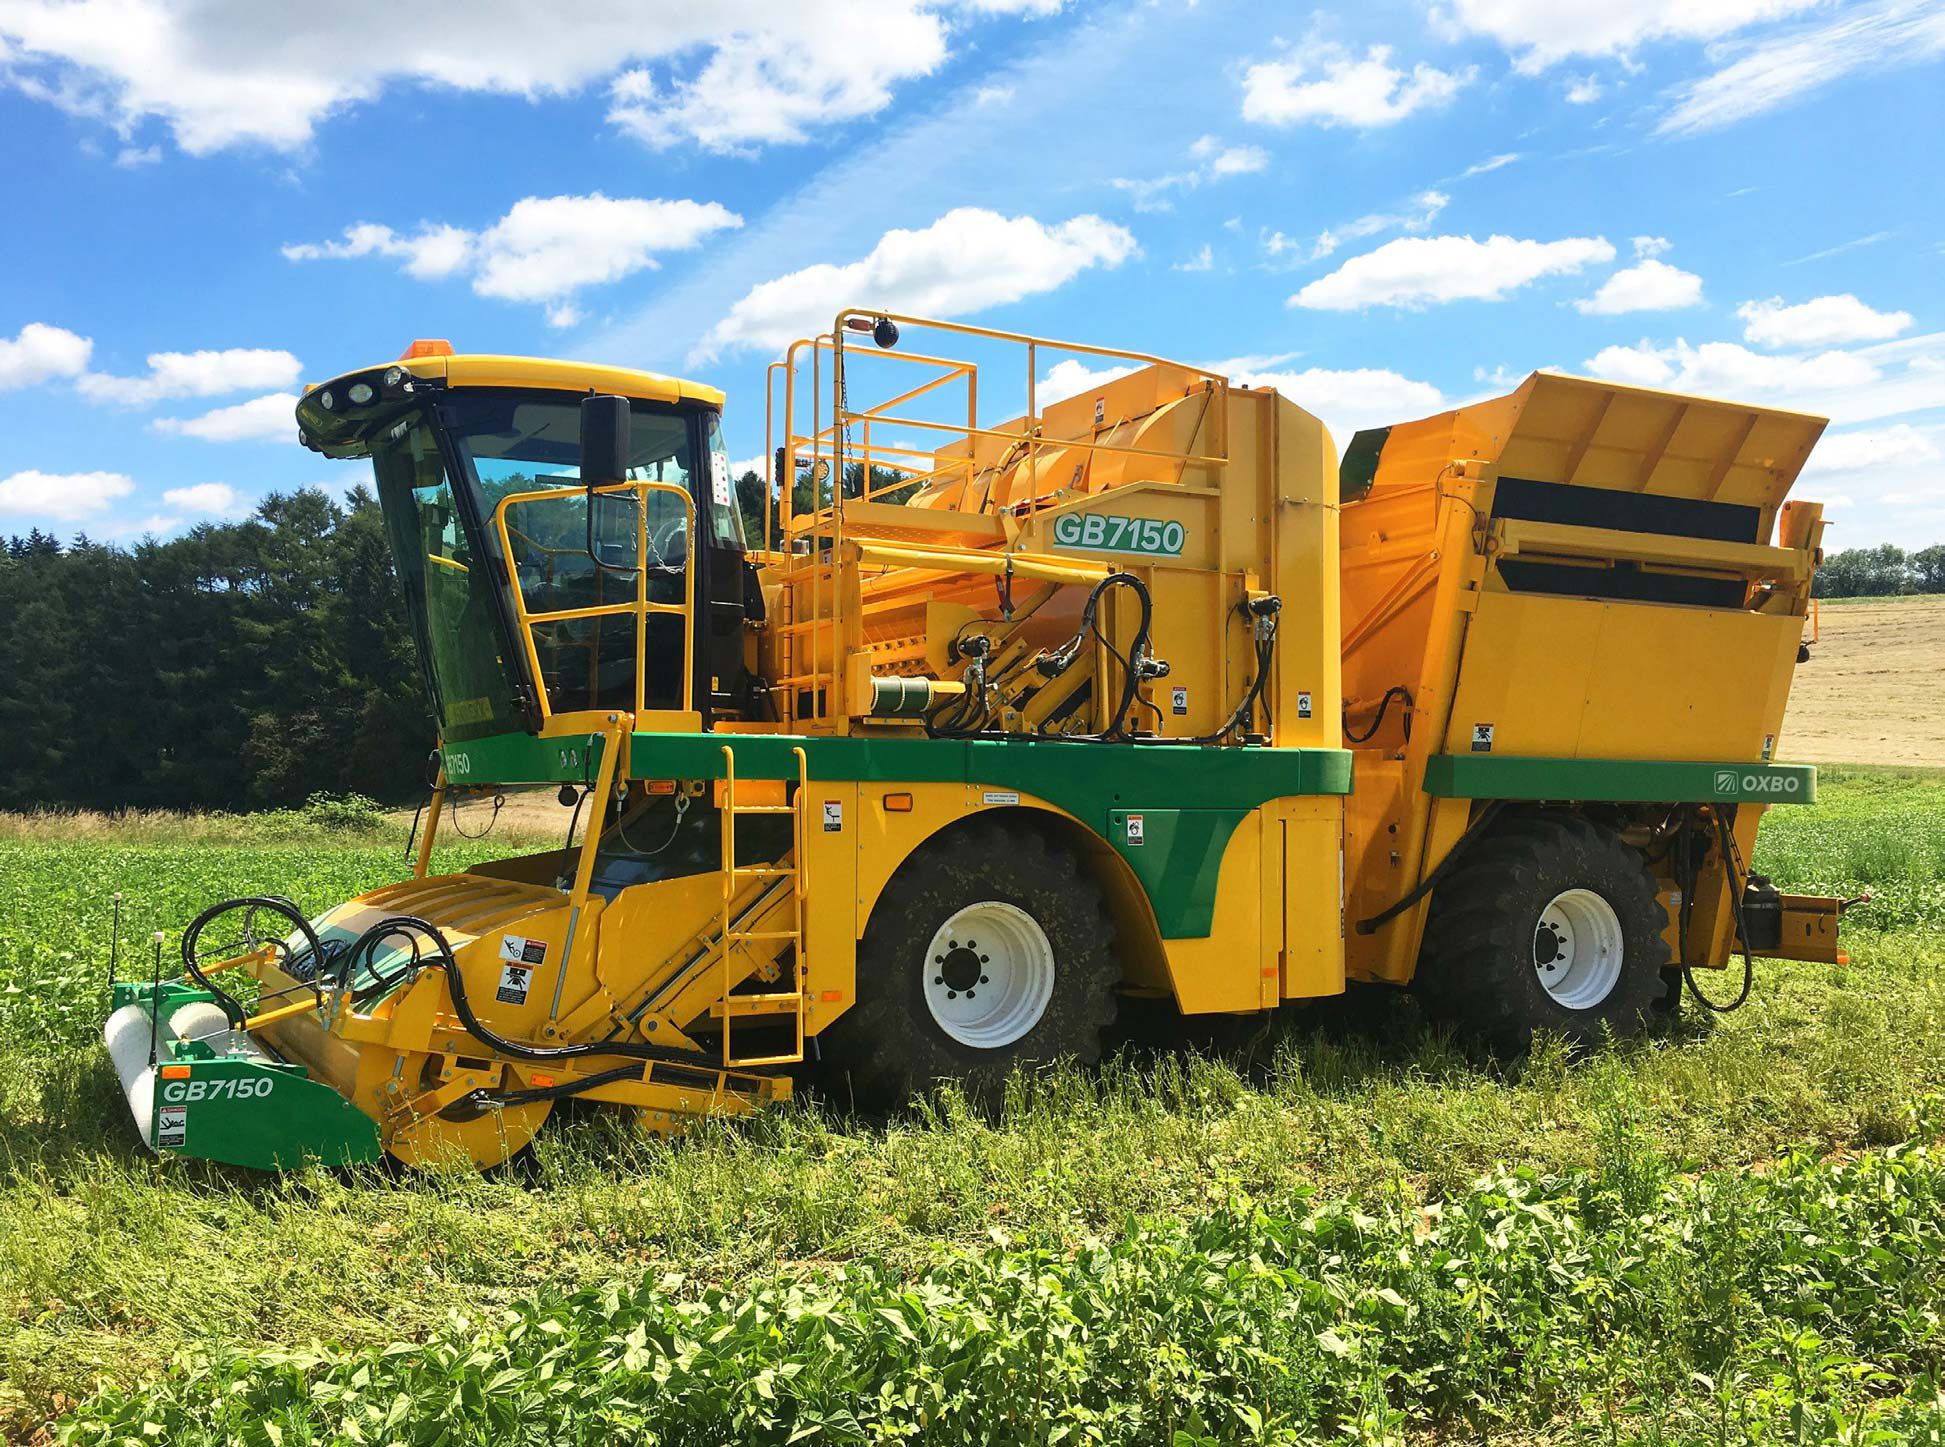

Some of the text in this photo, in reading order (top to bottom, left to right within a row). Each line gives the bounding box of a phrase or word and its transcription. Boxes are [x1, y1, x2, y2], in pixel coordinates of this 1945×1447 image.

[1055, 513, 1184, 552] GB7150
[1742, 775, 1799, 793] OXBO
[163, 1077, 274, 1101] GB7150
